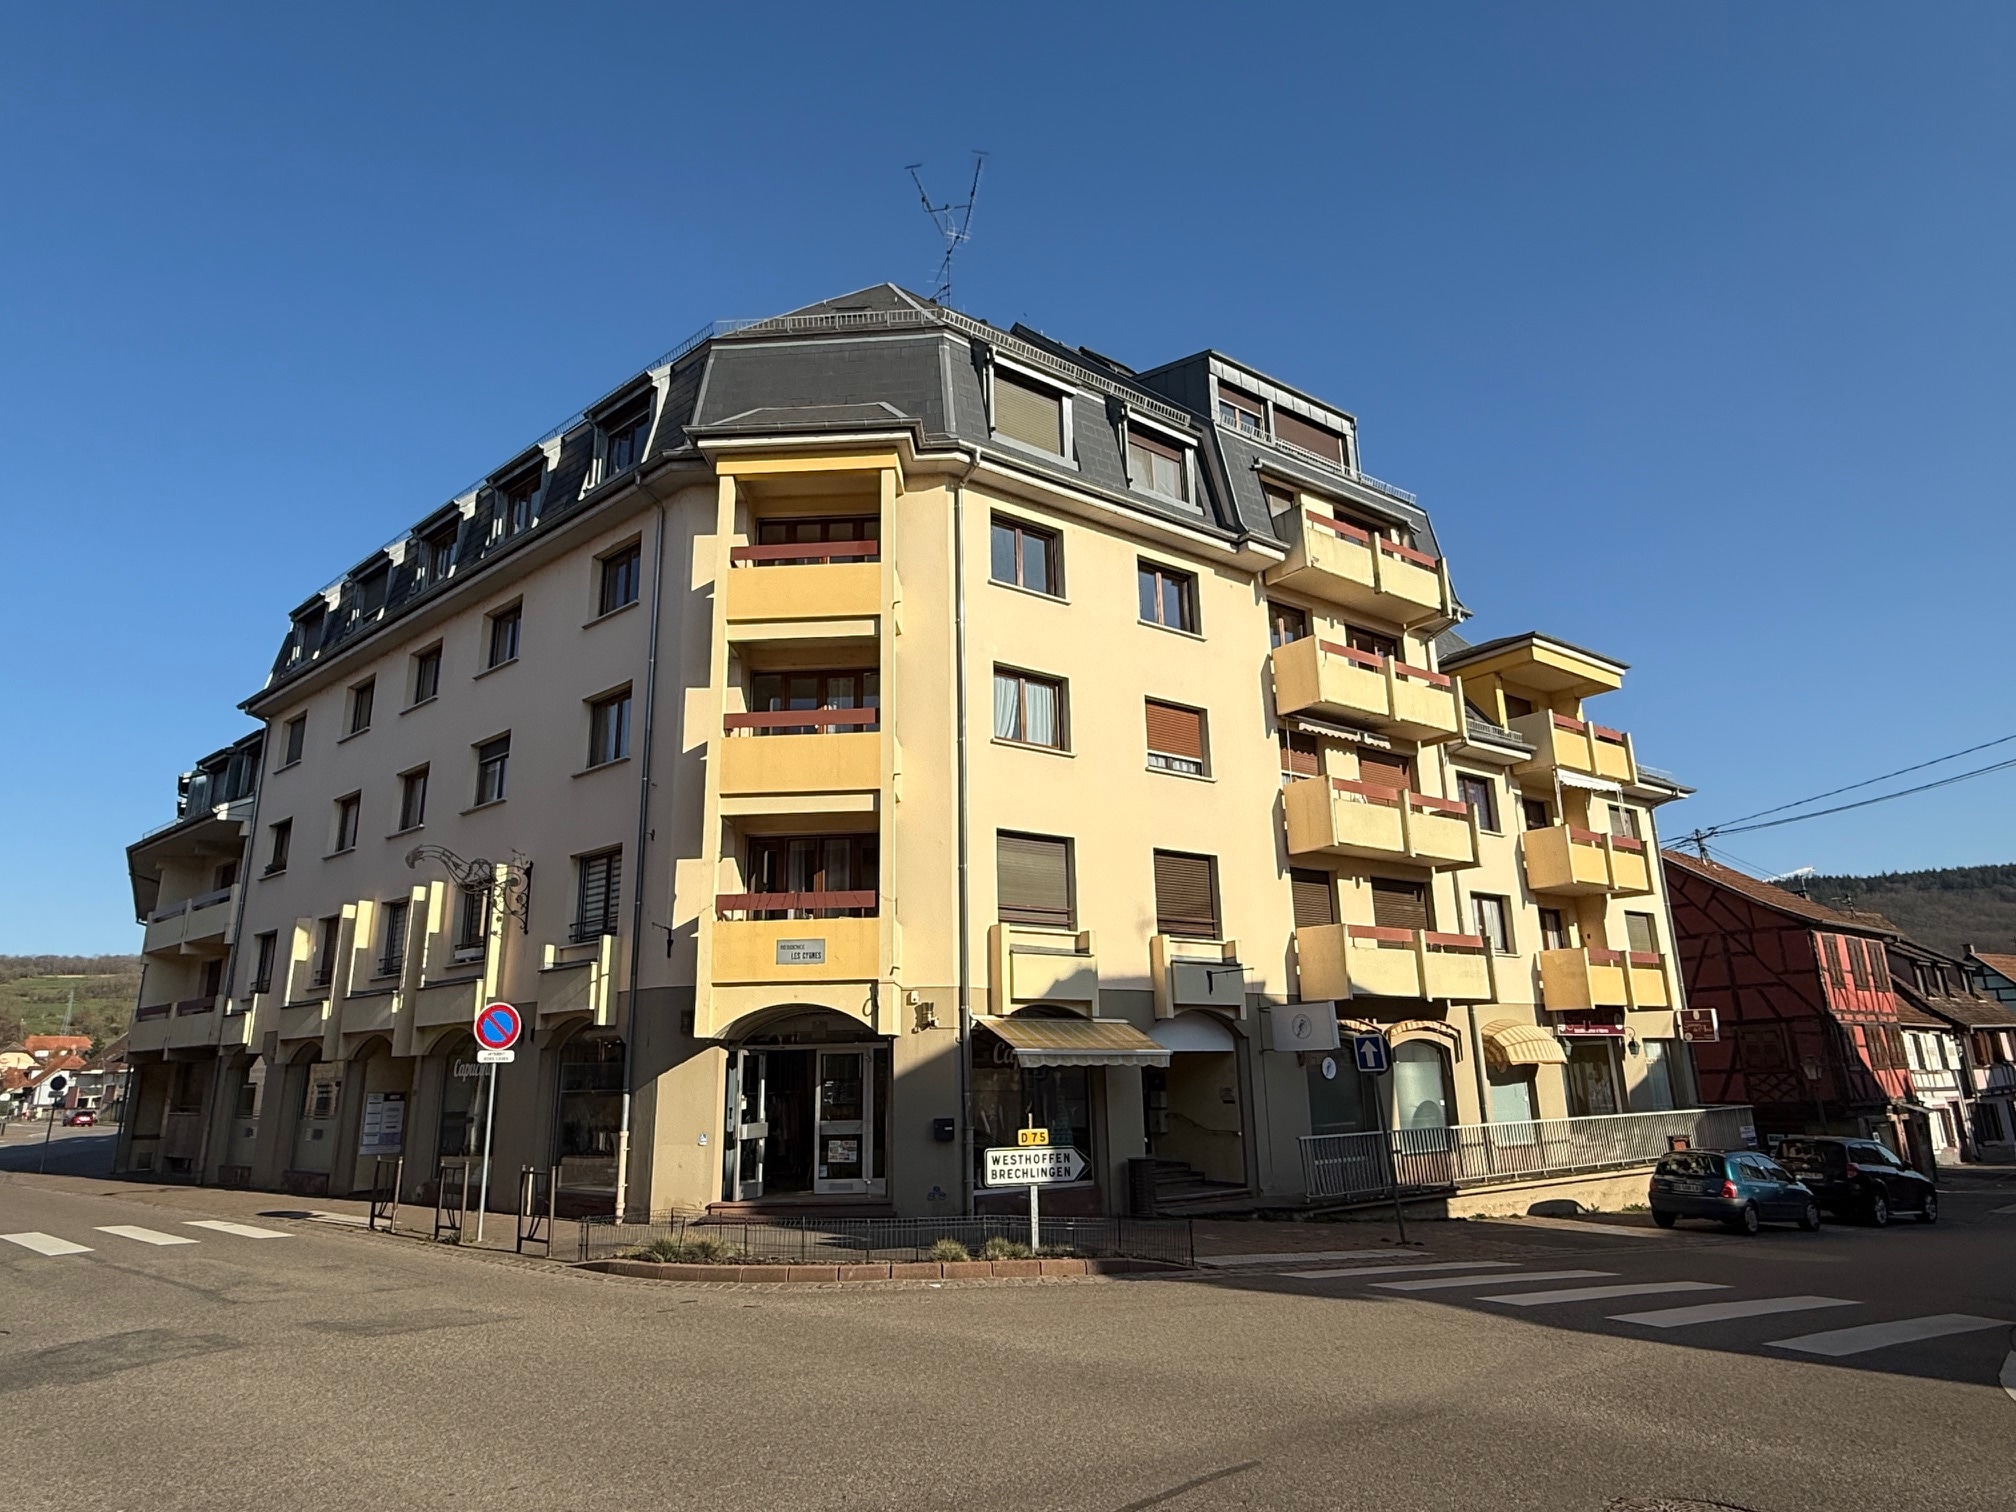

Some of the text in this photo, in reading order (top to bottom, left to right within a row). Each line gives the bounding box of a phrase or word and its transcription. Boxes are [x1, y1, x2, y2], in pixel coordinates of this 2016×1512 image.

[791, 952, 800, 960] LES
[1021, 1132, 1046, 1143] D 75
[991, 1153, 1071, 1165] WESTHOFFEN
[991, 1167, 1071, 1180] BRECHLINGEN
